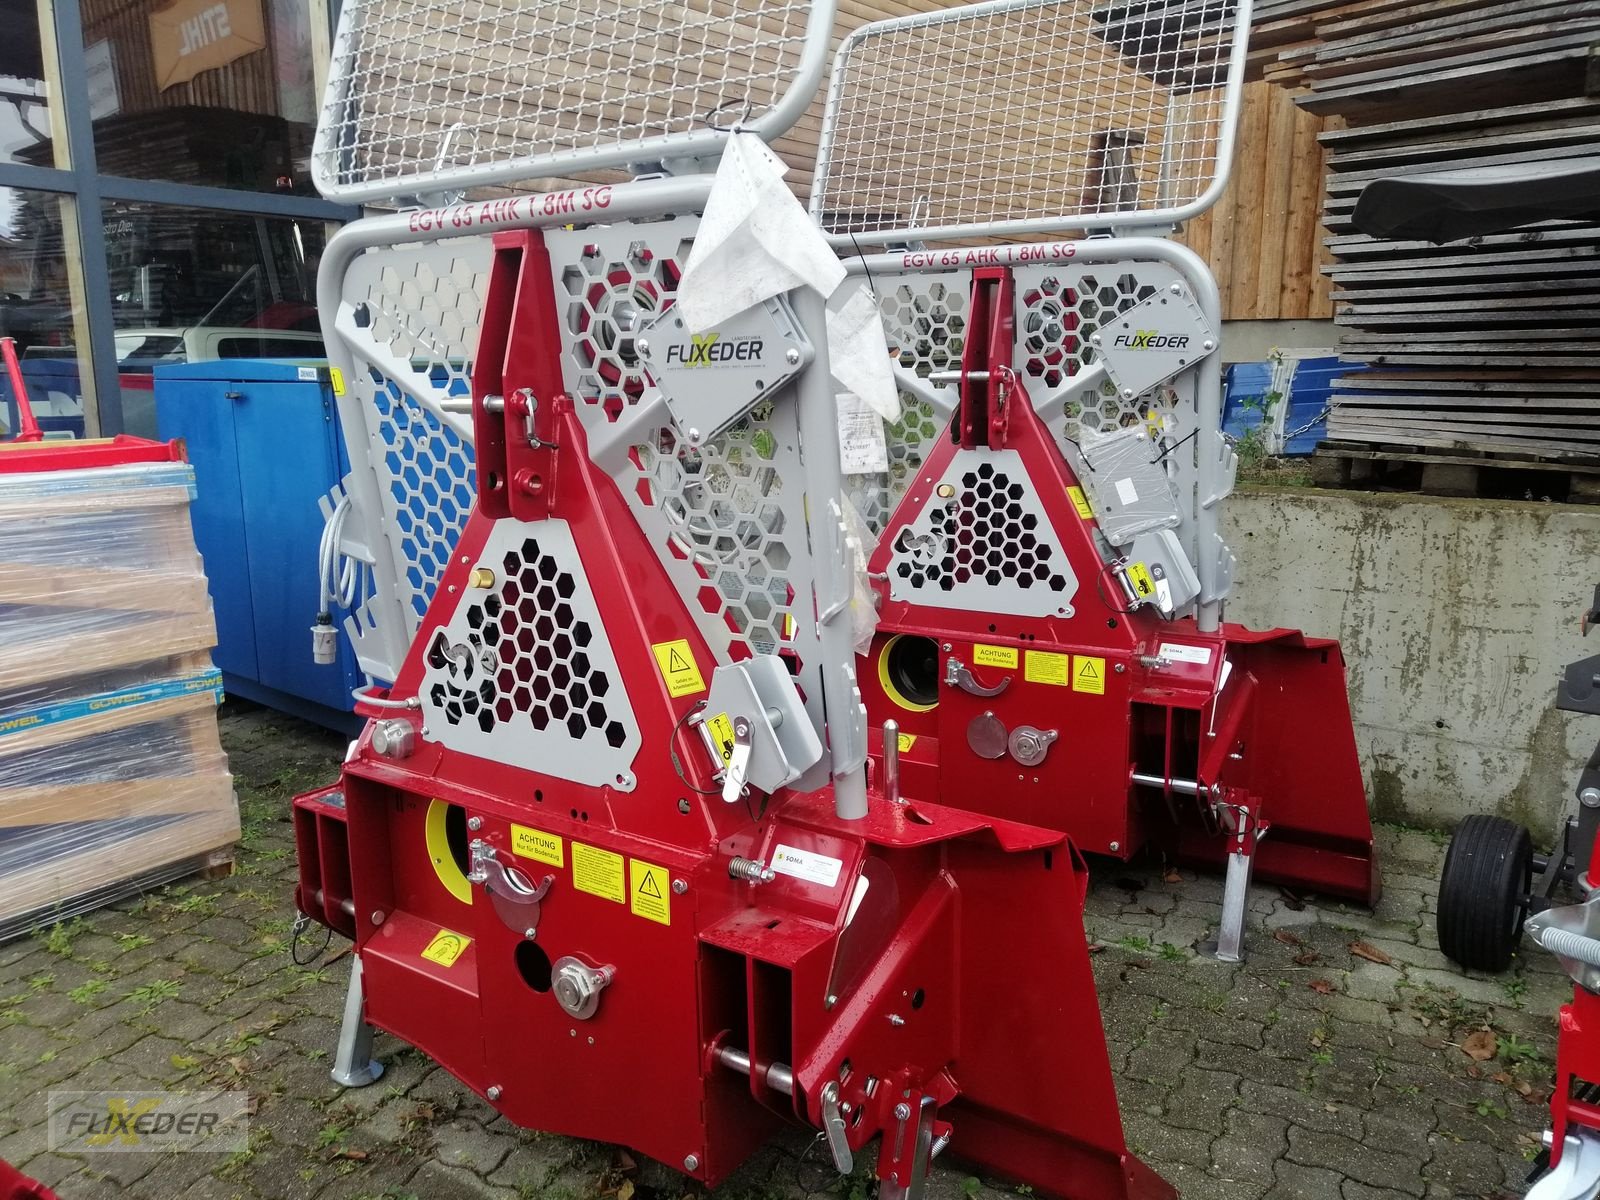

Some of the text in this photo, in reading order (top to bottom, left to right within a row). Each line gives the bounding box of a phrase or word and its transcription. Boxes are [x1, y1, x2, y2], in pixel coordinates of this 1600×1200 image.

[409, 186, 612, 232] EGV 65 AHK 1.8M SG
[903, 243, 1076, 268] EGV 65 AHK 1.8M SG
[1114, 333, 1190, 349] FLIXEDER
[667, 337, 763, 364] FLIXEDER
[980, 649, 1012, 659] ACHTUNG
[519, 833, 556, 850] ACHTUNG
[516, 842, 560, 862] Nur für Bodenzug
[785, 855, 803, 865] SOMA
